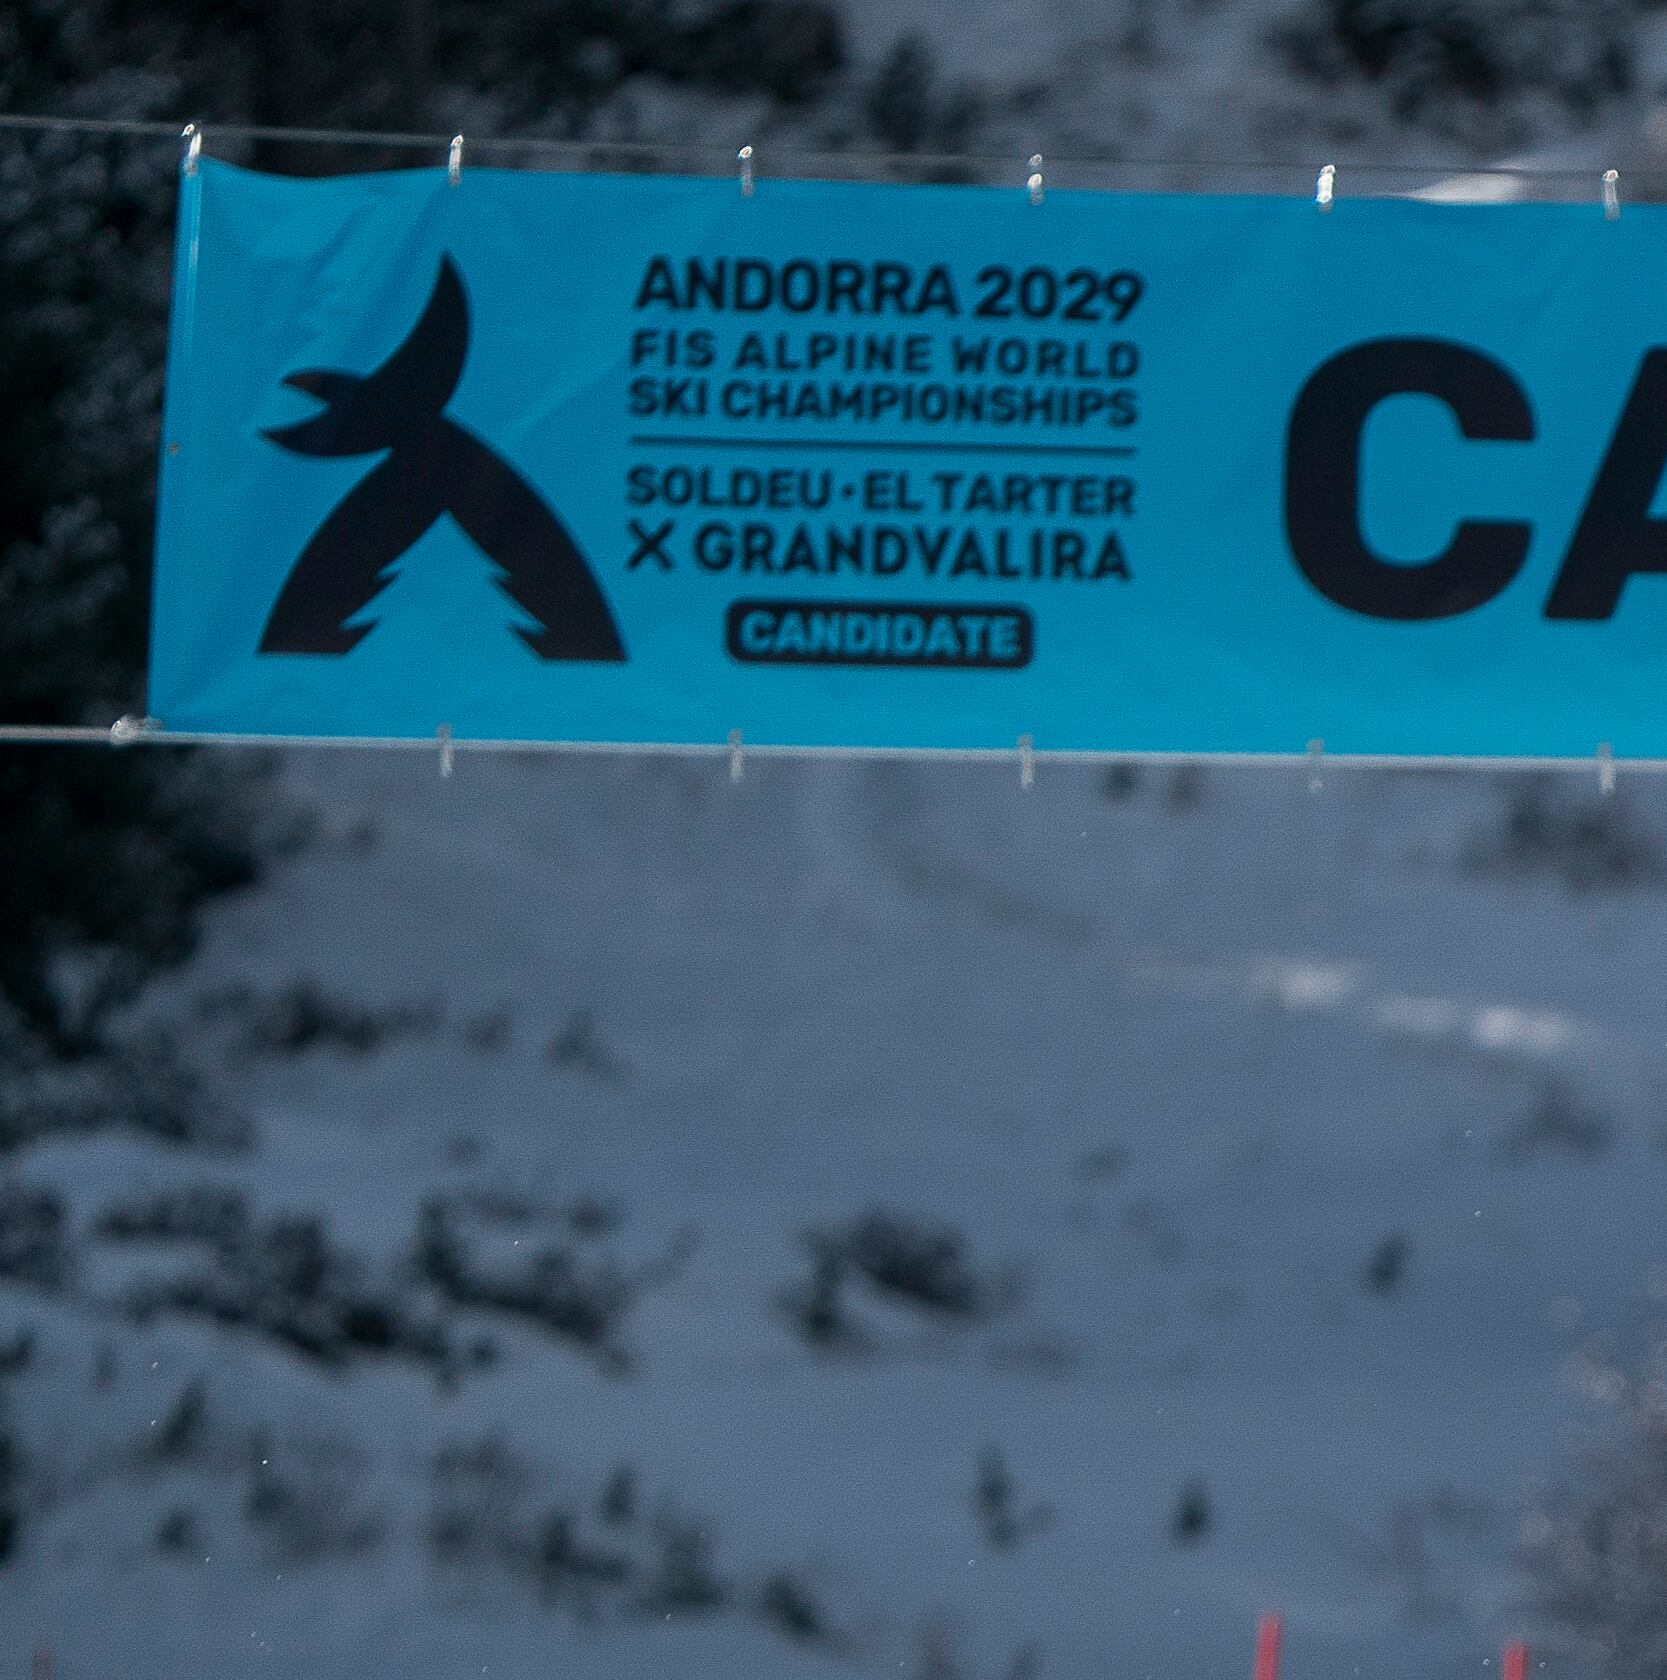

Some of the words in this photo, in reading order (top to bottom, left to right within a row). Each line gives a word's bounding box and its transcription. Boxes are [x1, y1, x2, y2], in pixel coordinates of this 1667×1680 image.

[633, 255, 960, 318] ANDORRA
[972, 265, 1146, 325] 2029
[630, 328, 716, 369] FIS
[733, 332, 930, 375] ALPINE
[951, 338, 1140, 381] WORLD
[628, 376, 709, 418] SKI
[719, 380, 1138, 430] CHAMPIONSHIPS
[933, 472, 1136, 517] TARTER
[691, 521, 1132, 582] GRANDVALIRA
[738, 610, 1022, 660] CANDIDATE
